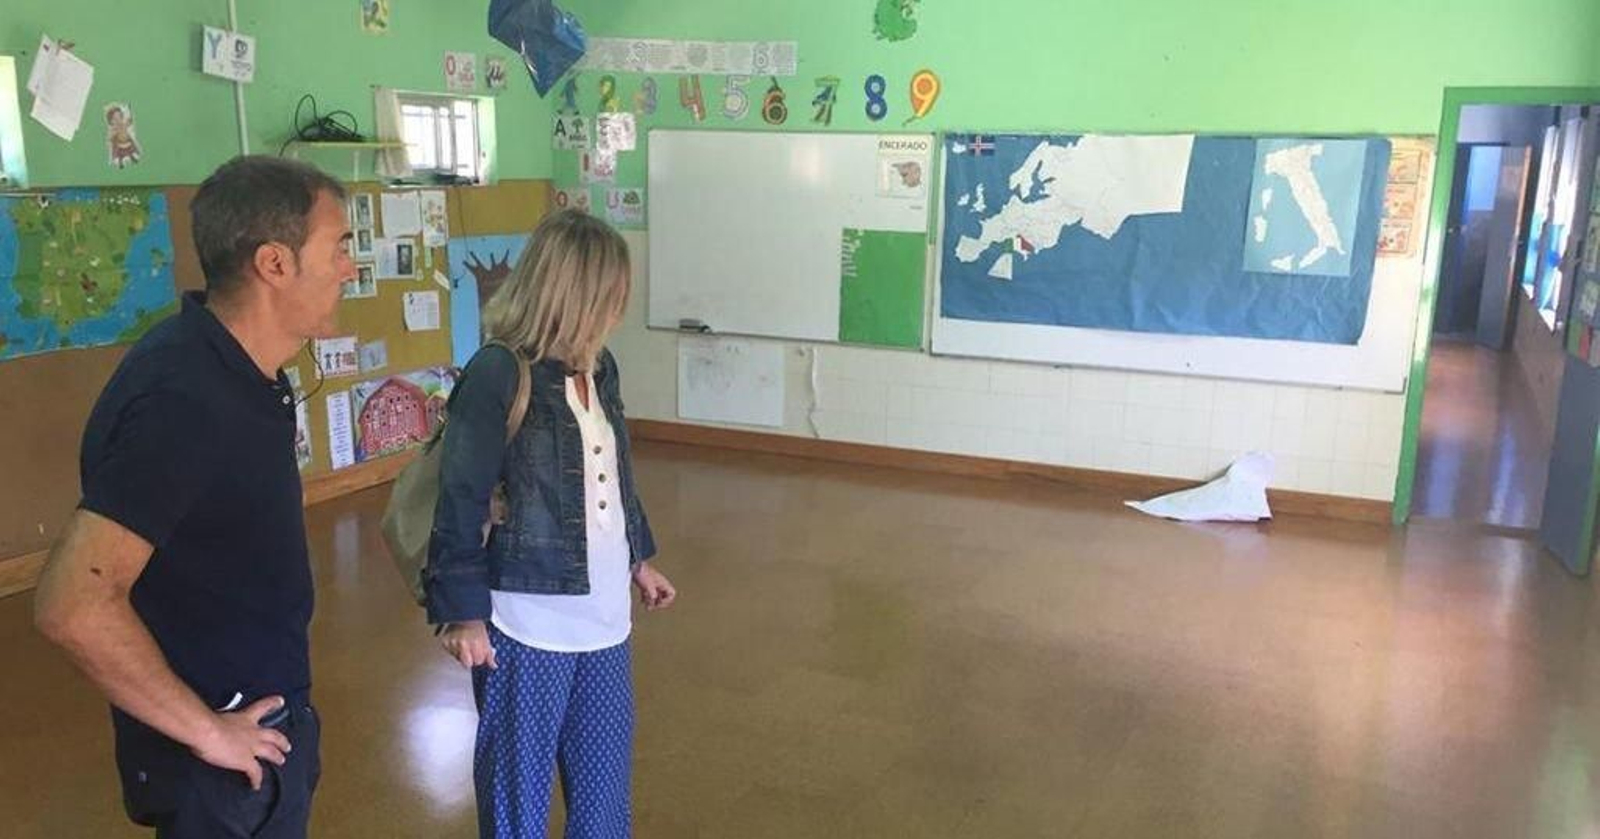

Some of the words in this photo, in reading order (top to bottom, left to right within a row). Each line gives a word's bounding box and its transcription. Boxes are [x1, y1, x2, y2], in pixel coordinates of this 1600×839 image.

[864, 74, 887, 121] 8
[910, 69, 940, 121] 9
[554, 118, 566, 136] A
[878, 140, 927, 151] ENCERADO
